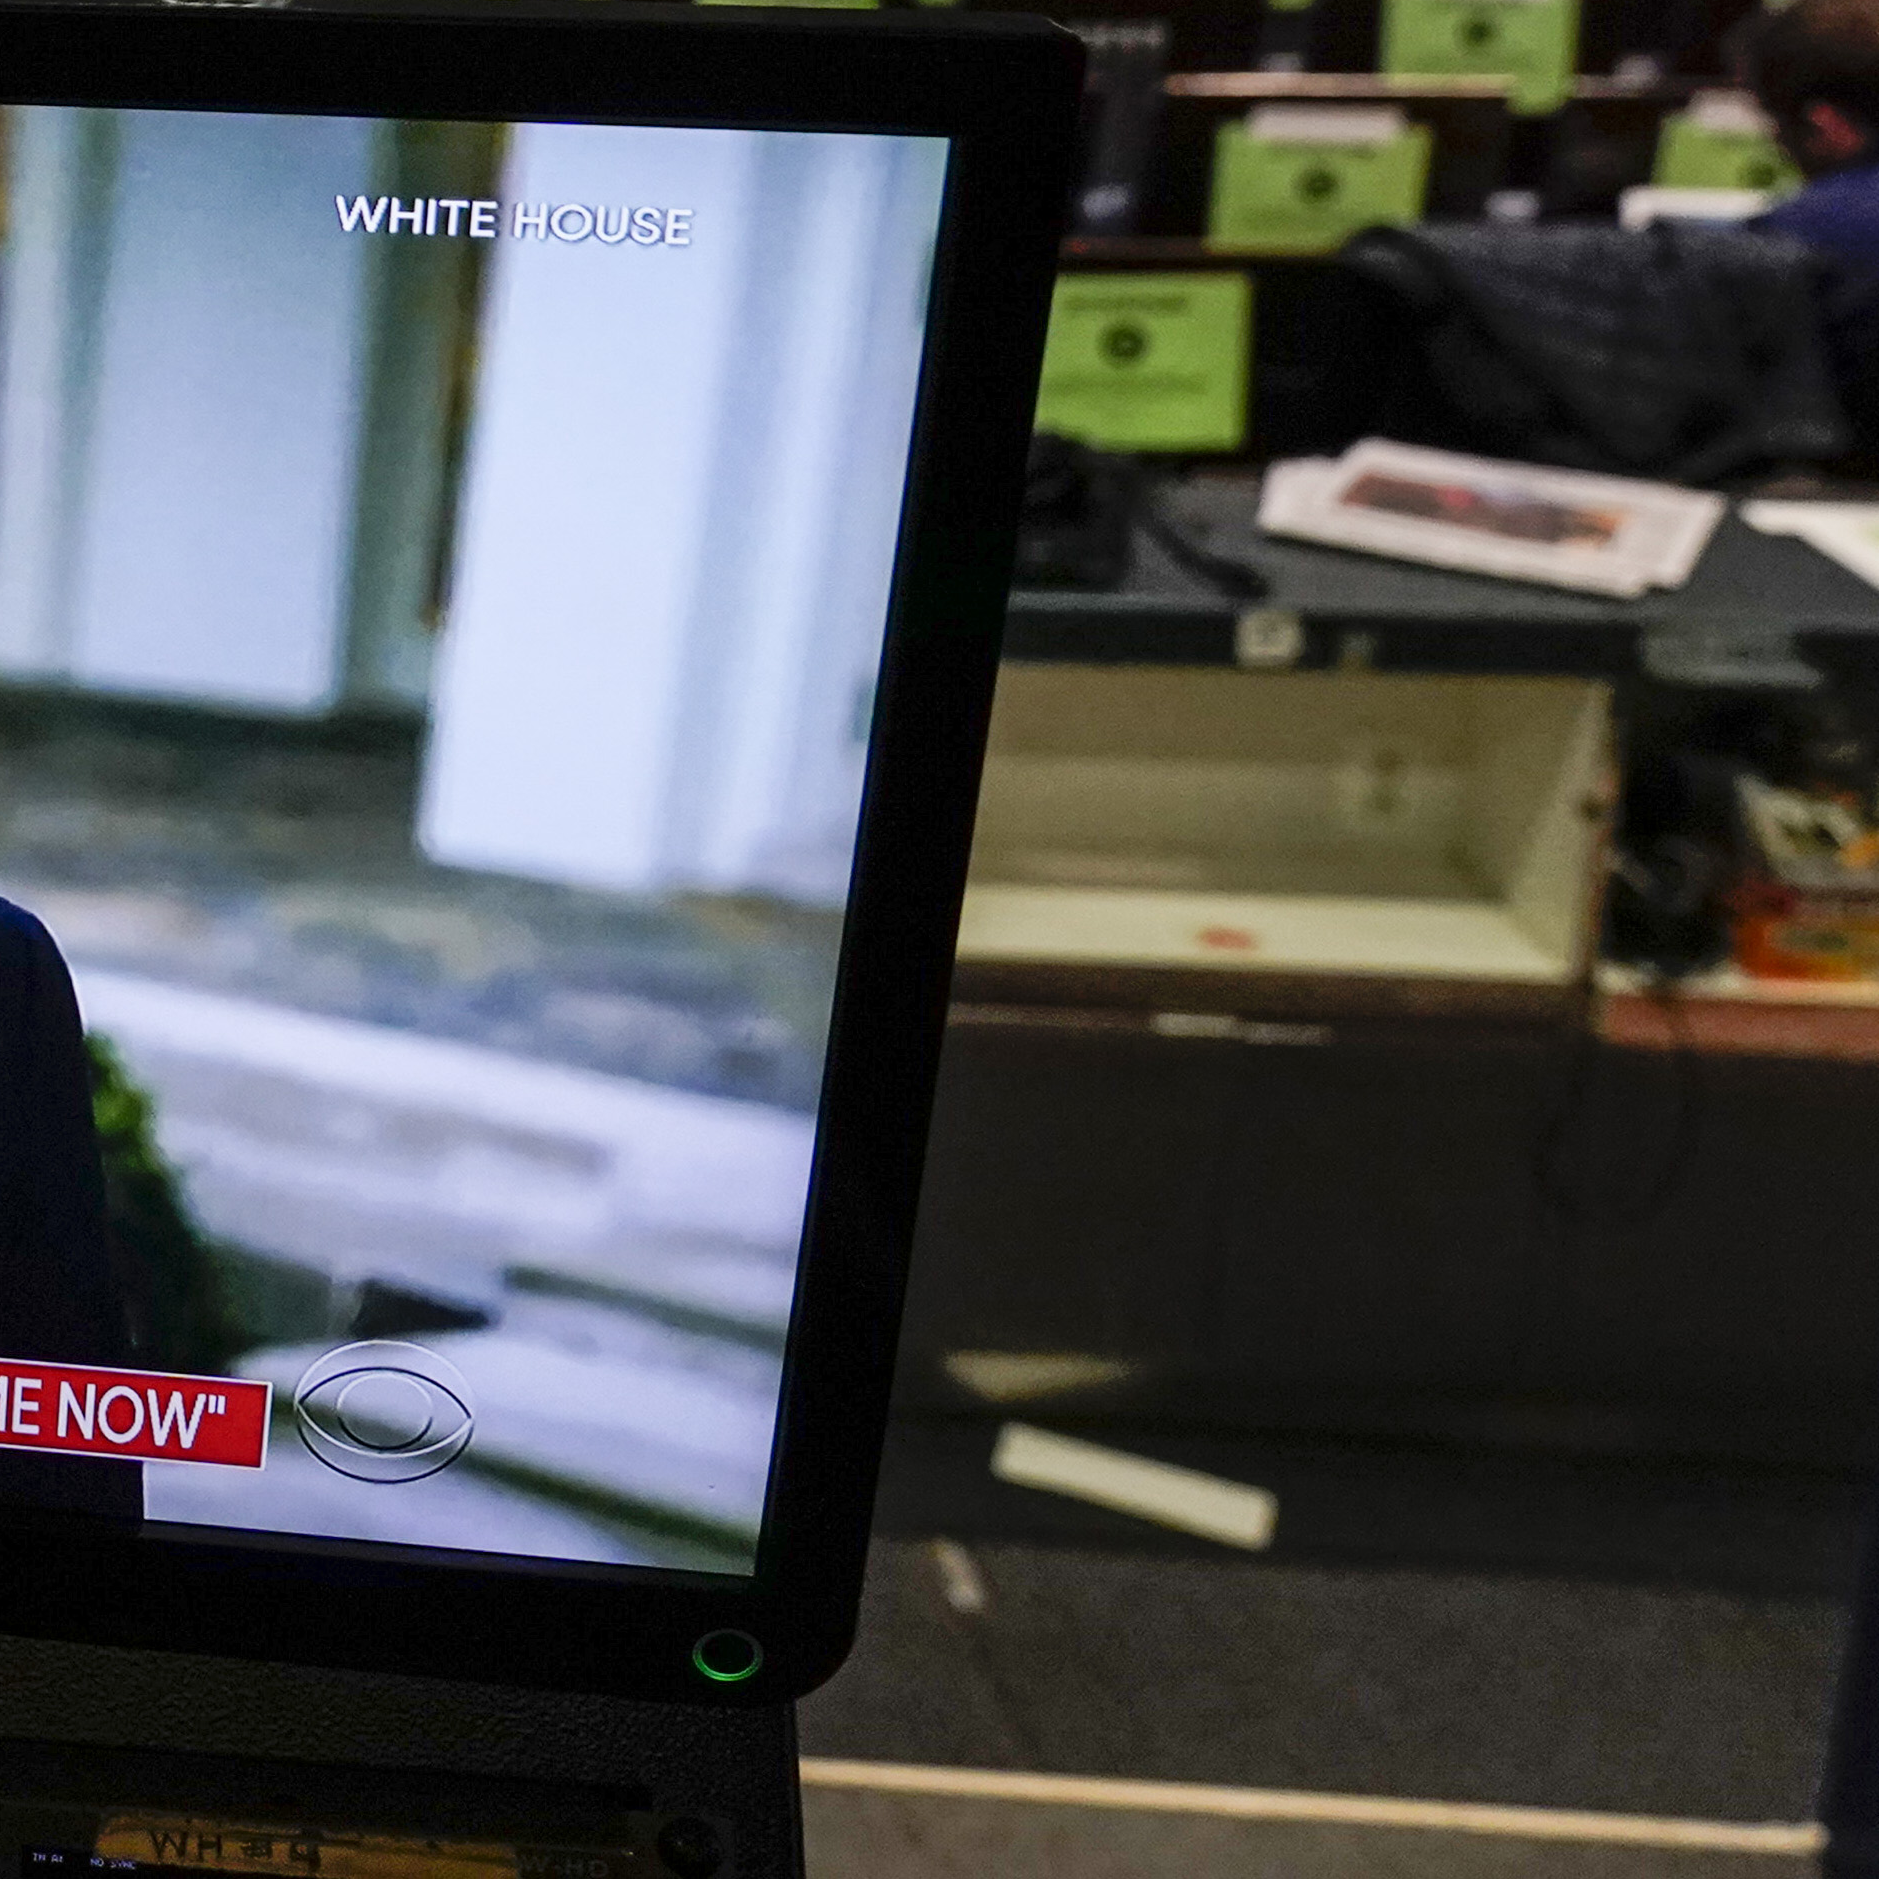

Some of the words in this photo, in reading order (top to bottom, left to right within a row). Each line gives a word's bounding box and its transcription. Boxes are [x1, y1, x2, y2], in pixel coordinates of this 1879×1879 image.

[335, 194, 498, 238] WHITE
[513, 202, 693, 246] HOUSE
[57, 1381, 226, 1449] NOW"
